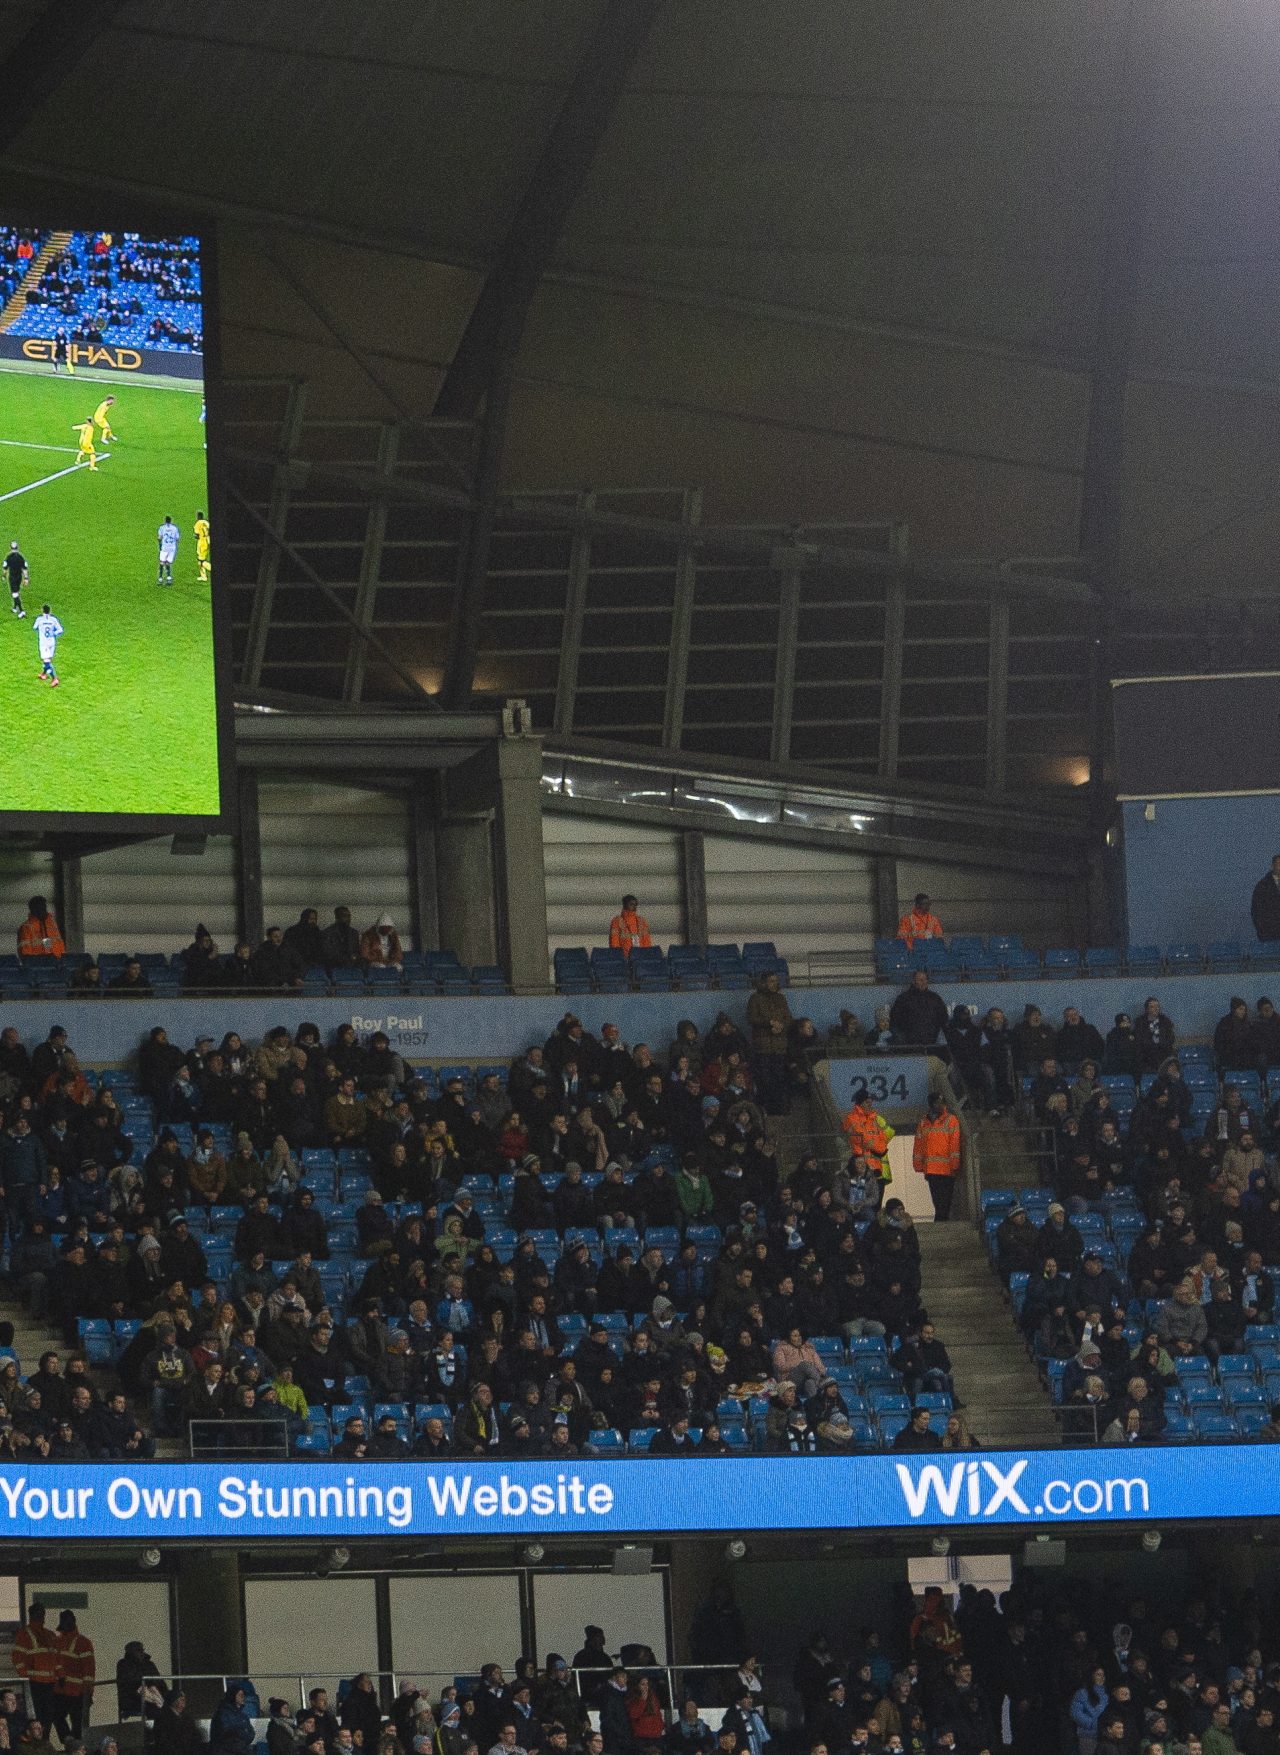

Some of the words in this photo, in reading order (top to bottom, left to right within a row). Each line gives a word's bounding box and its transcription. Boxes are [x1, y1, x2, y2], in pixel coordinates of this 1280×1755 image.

[351, 1015, 382, 1032] Roy
[386, 1014, 423, 1031] Paul
[850, 1074, 909, 1102] 234
[107, 1477, 203, 1520] Own
[218, 1477, 412, 1527] Stunning
[427, 1474, 614, 1516] Website
